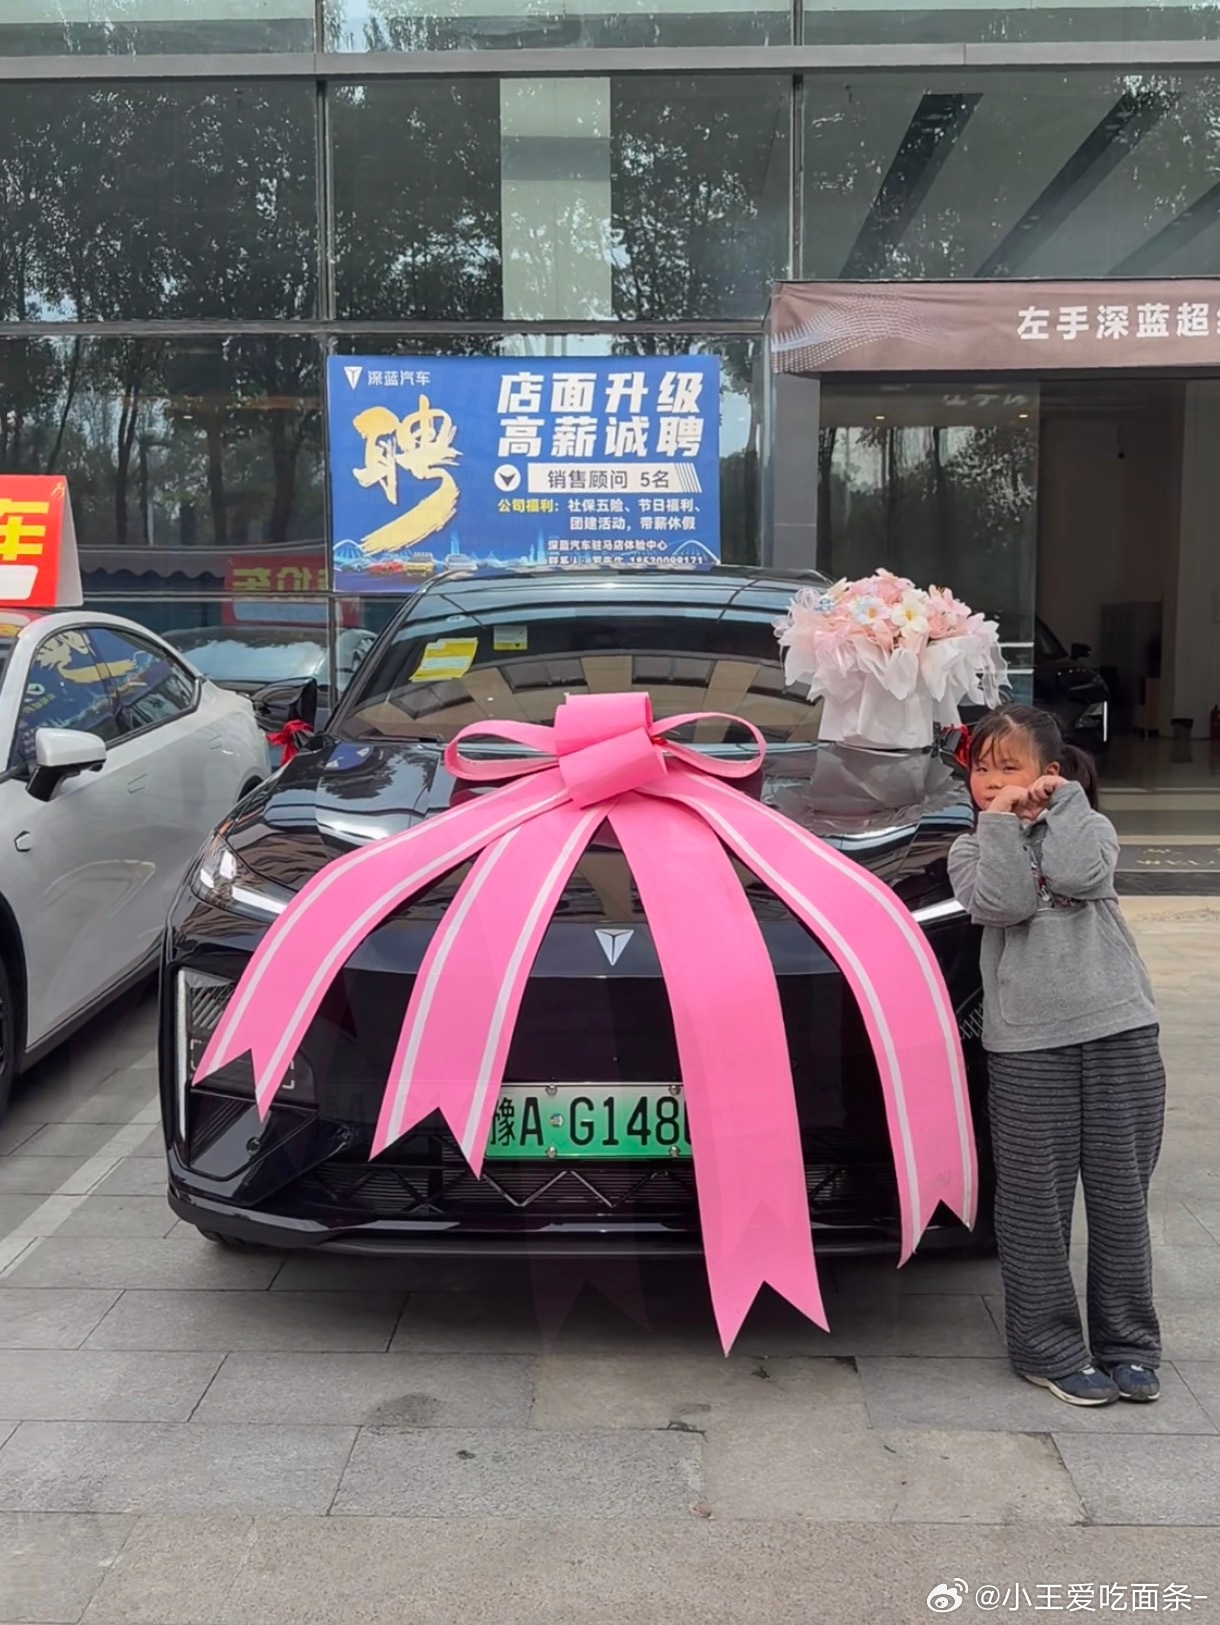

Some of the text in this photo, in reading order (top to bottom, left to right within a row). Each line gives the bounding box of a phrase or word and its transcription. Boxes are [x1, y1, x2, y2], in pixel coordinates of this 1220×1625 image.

[1017, 302, 1220, 340] 左手深蓝超
[367, 370, 431, 386] 深蓝汽车
[497, 371, 704, 413] 店面升级
[498, 416, 704, 457] 高薪诚聘
[352, 394, 464, 557] 聘
[547, 470, 670, 489] 销售顾问 5名
[547, 540, 668, 551] 深蓝汽车驻马店体验中心
[569, 1096, 692, 1146] G148
